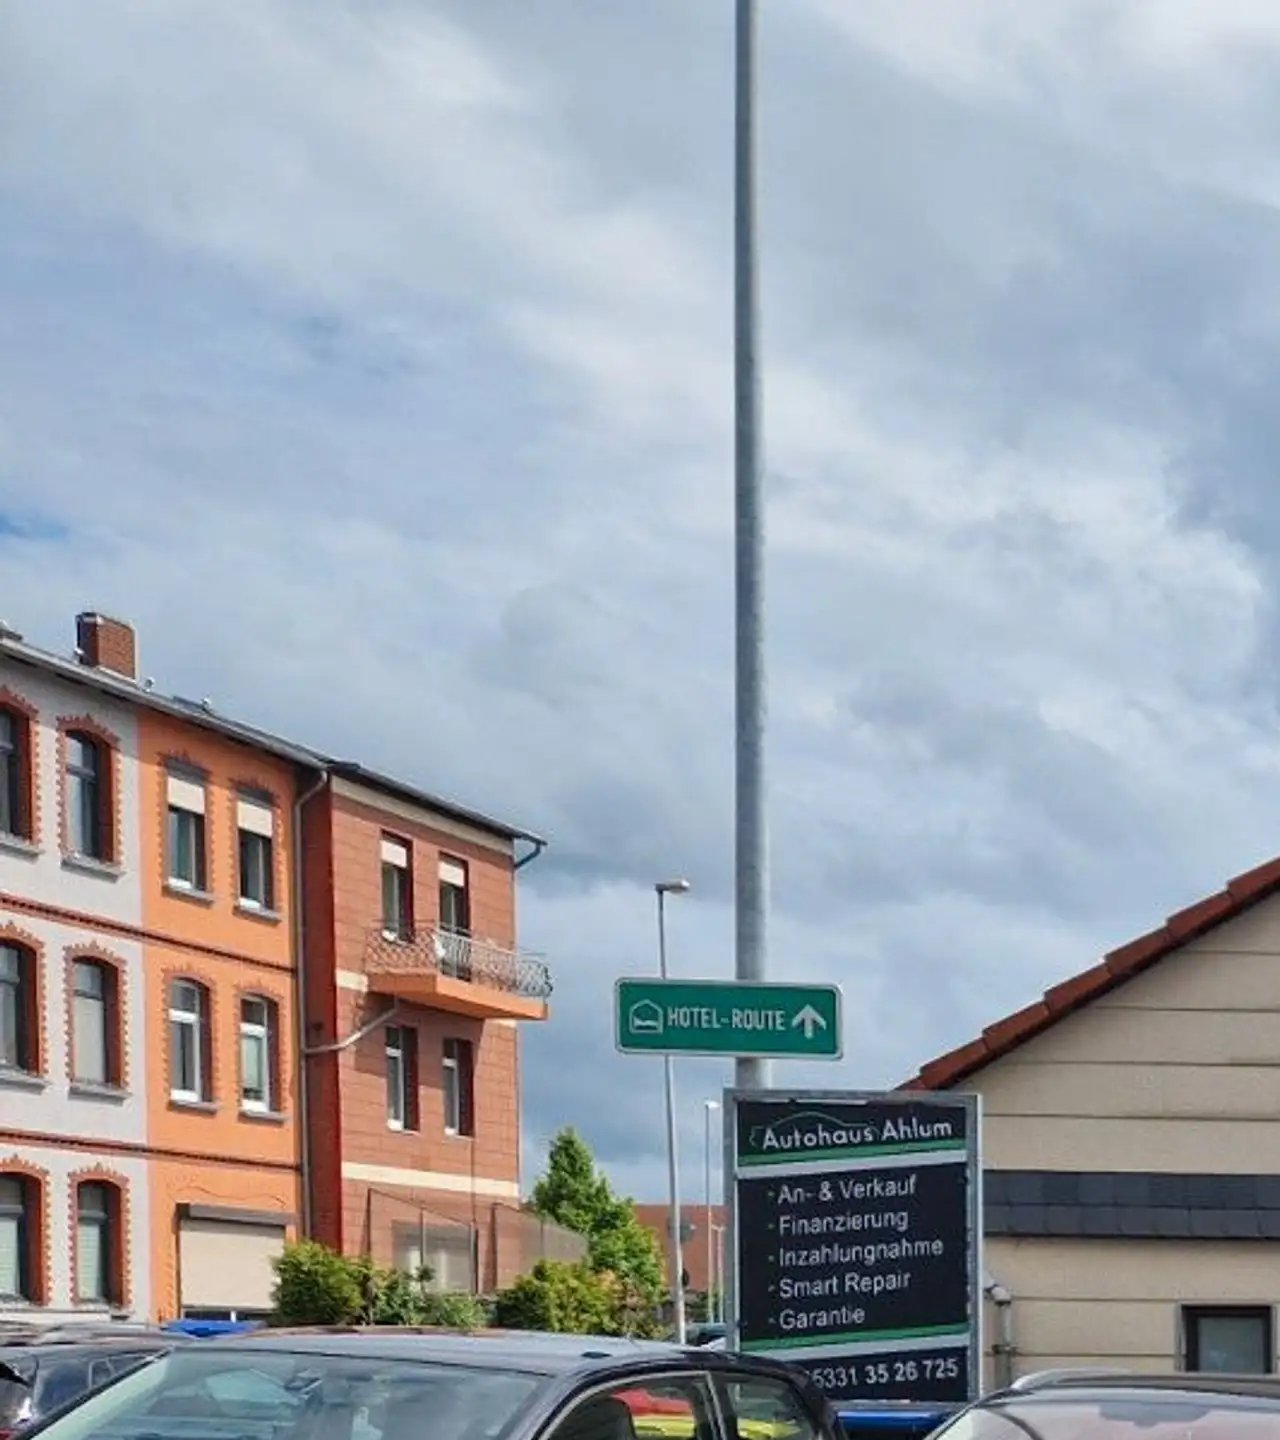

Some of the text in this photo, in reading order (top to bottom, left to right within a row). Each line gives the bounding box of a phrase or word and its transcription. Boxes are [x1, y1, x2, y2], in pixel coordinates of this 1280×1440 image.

[667, 1006, 786, 1031] HOTEL-ROUTE
[762, 1117, 953, 1150] Autohaus Ahlum
[778, 1174, 917, 1204] An- & Verkauf
[779, 1211, 909, 1236] Finanzierung
[779, 1238, 944, 1267] Inzahlungnahme
[779, 1271, 911, 1298] Smart Repair
[779, 1306, 865, 1330] Garantie
[806, 1357, 959, 1389] 5331 35 26 725
